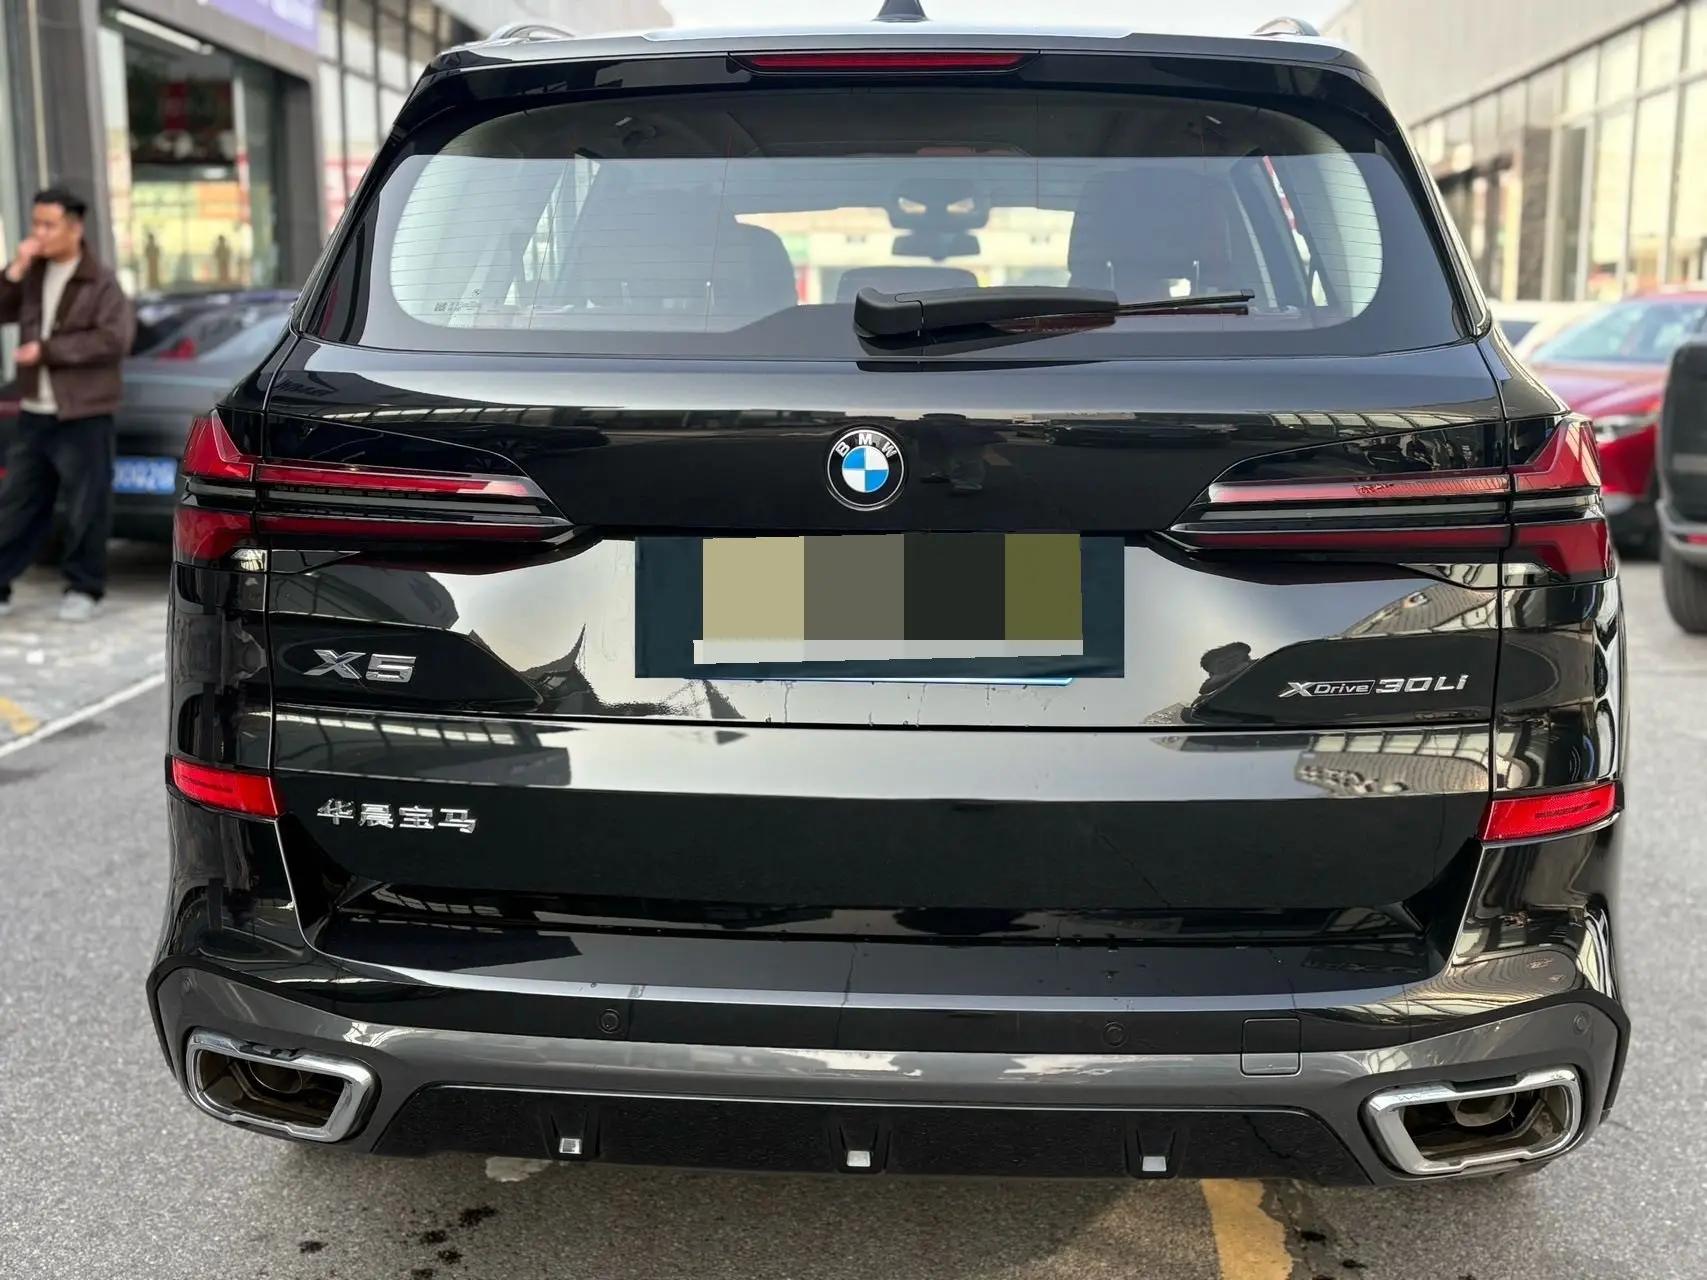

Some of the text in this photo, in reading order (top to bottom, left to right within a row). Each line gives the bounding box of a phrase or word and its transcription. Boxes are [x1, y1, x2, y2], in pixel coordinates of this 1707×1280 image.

[835, 433, 897, 458] BMW
[303, 649, 416, 682] X5
[317, 799, 477, 833] 华晨宝马
